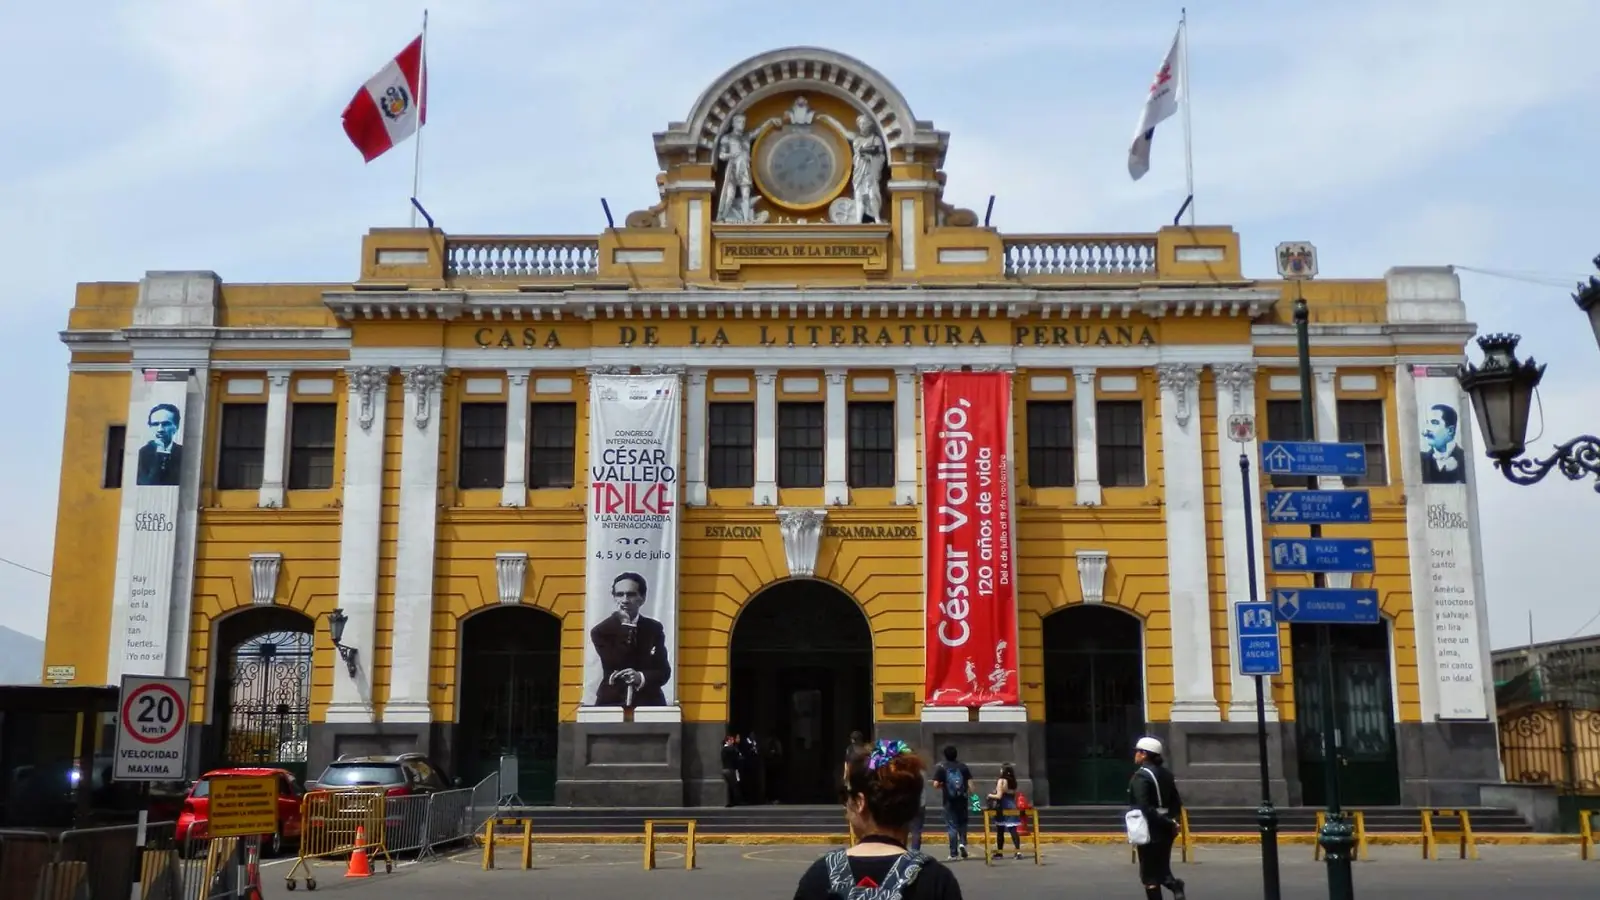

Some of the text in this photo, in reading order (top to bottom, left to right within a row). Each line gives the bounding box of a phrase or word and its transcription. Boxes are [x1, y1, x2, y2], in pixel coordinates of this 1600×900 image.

[725, 246, 879, 256] PRESIDENCIA DE LA REPUBLICA
[474, 324, 1156, 348] CASA DE LA LITERATURA PERUANA
[603, 445, 666, 465] CÉSAR
[592, 466, 676, 483] VALLEJO,
[999, 454, 1007, 497] noviembre
[592, 482, 674, 514] TRILCE
[1000, 500, 1008, 510] de
[135, 510, 166, 522] CÉSAR
[614, 514, 671, 522] VANGUARDIA
[1427, 511, 1462, 521] SANTOS
[135, 521, 173, 531] VALLEJO
[938, 398, 973, 647] César Vallejo,
[974, 447, 993, 597] 120 años de vida
[705, 526, 917, 538] ESTACION DESAMPARADOS
[595, 549, 671, 561] 4, 5 y 6 de julio
[1000, 550, 1008, 562] de
[1430, 548, 1444, 558] Soy
[132, 574, 147, 585] Hay
[1000, 570, 1009, 585] Del
[131, 587, 156, 598] golpes
[130, 600, 149, 609] en la
[1435, 612, 1440, 620] y
[128, 627, 141, 635] tan
[1448, 623, 1461, 631] lira
[140, 653, 150, 661] no
[137, 695, 174, 723] 20
[141, 724, 167, 734] km/h
[121, 750, 178, 759] VELOCIDAD
[127, 764, 169, 774] MAXIMA
